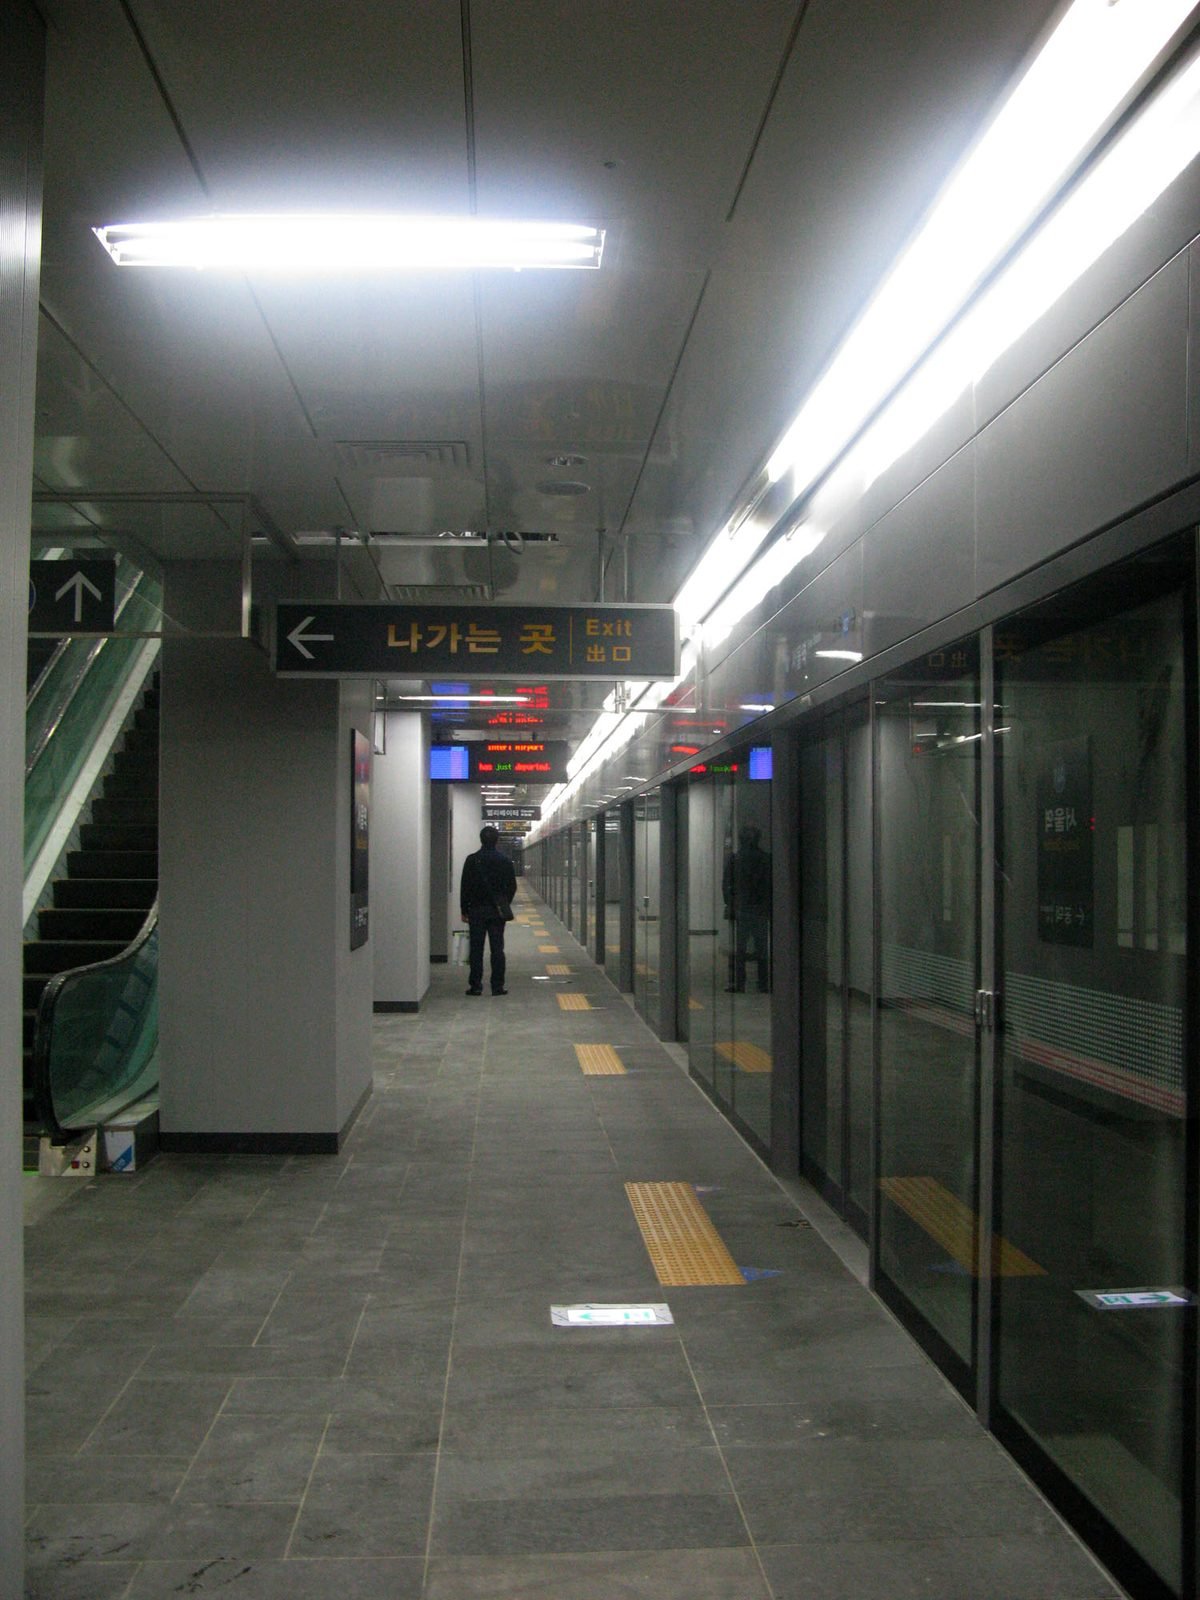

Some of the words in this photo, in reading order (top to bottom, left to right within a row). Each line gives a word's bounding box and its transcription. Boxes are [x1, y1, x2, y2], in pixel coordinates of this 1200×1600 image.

[586, 618, 633, 638] Exit
[386, 622, 502, 654] 나가는
[519, 623, 557, 655] 곳
[586, 645, 632, 663] 出口
[495, 762, 512, 771] just
